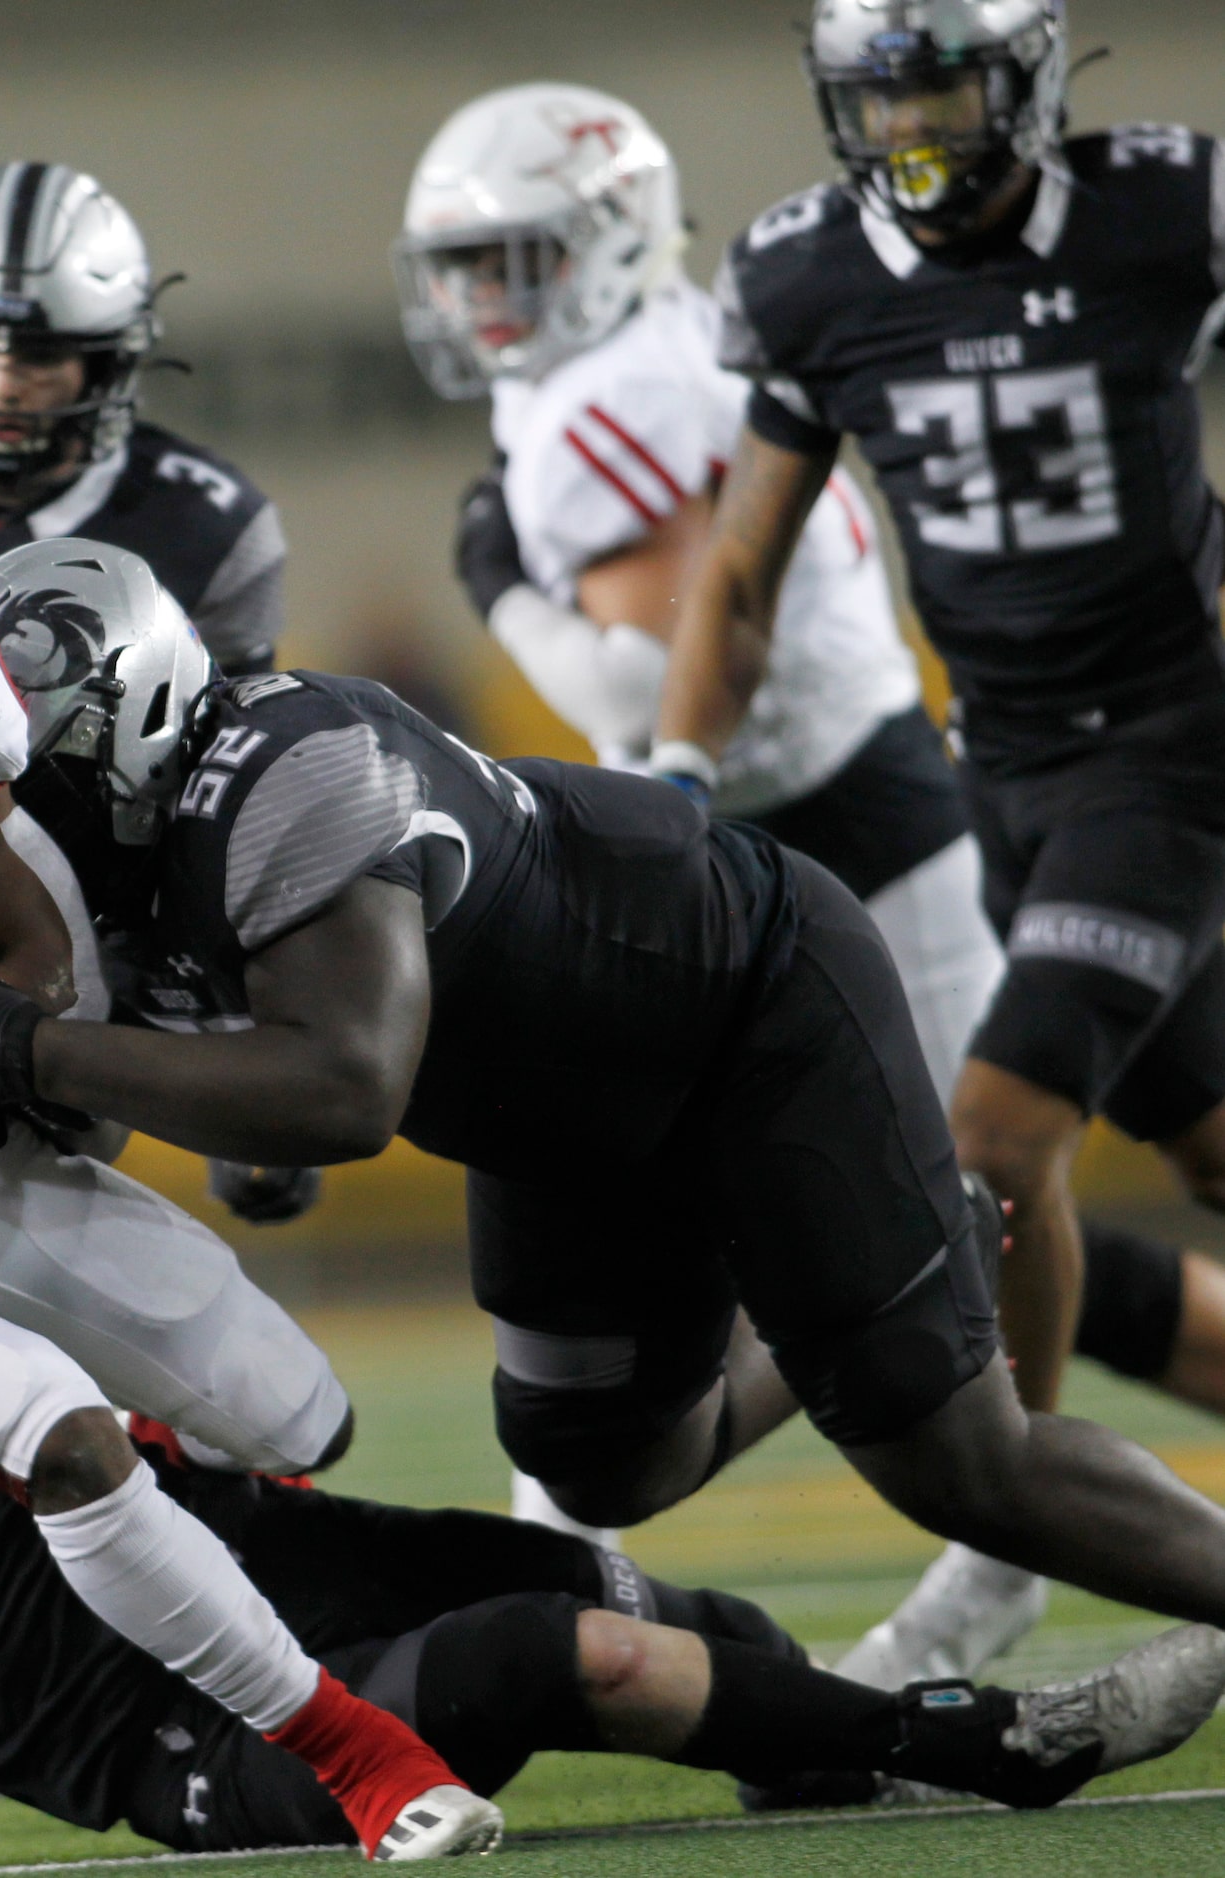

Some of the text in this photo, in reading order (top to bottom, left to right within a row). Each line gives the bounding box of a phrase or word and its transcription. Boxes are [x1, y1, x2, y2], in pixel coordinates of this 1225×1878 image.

[155, 451, 242, 513] 3
[884, 362, 1124, 554] 33
[178, 724, 271, 820] 52
